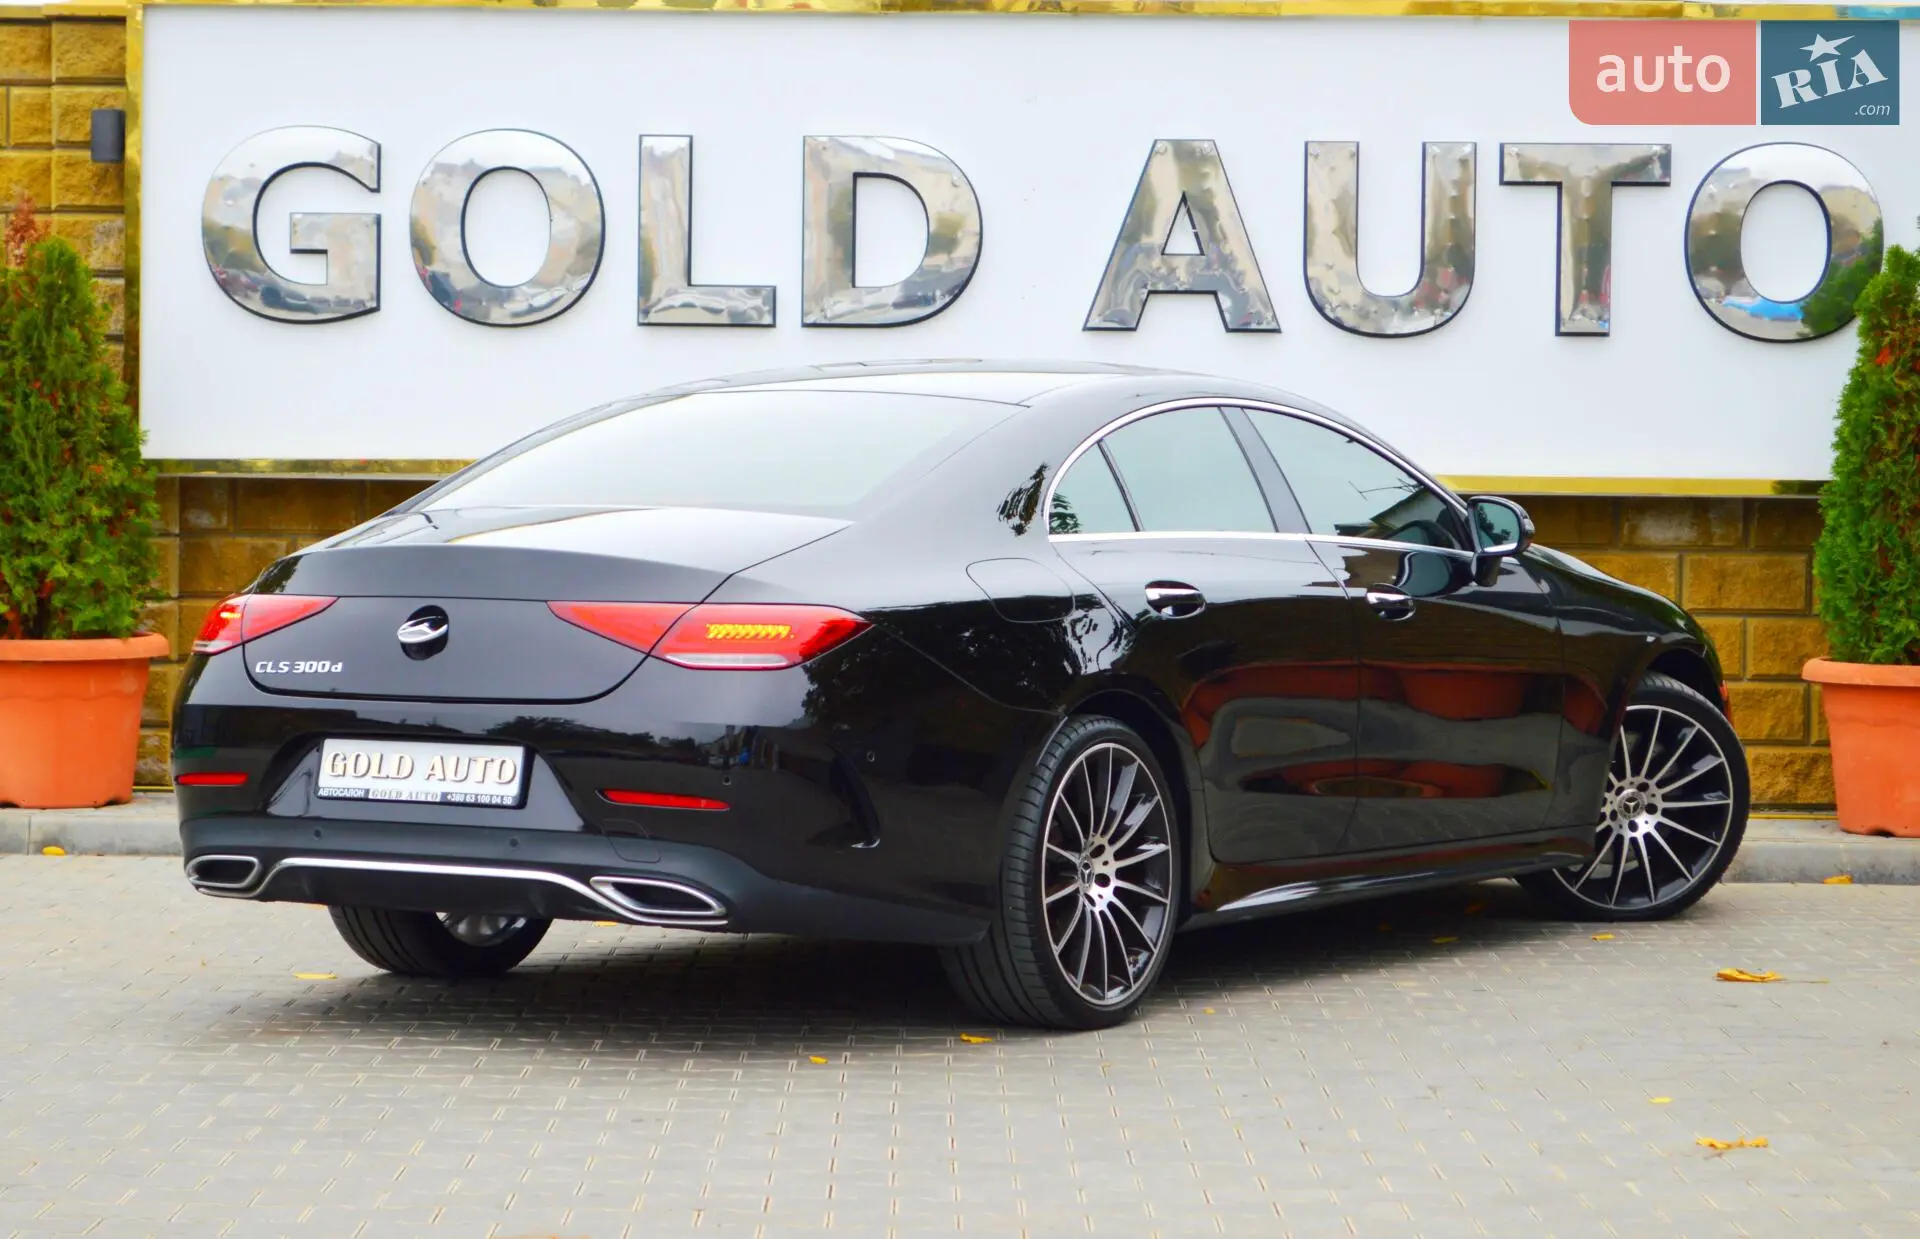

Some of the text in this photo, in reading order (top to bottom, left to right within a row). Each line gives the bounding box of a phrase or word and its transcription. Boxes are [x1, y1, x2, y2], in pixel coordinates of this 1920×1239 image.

[201, 125, 1885, 343] GOLD AUTO
[255, 661, 290, 673] CLS
[324, 751, 517, 785] GOLD AUTO
[371, 789, 439, 801] GOLD AUTO
